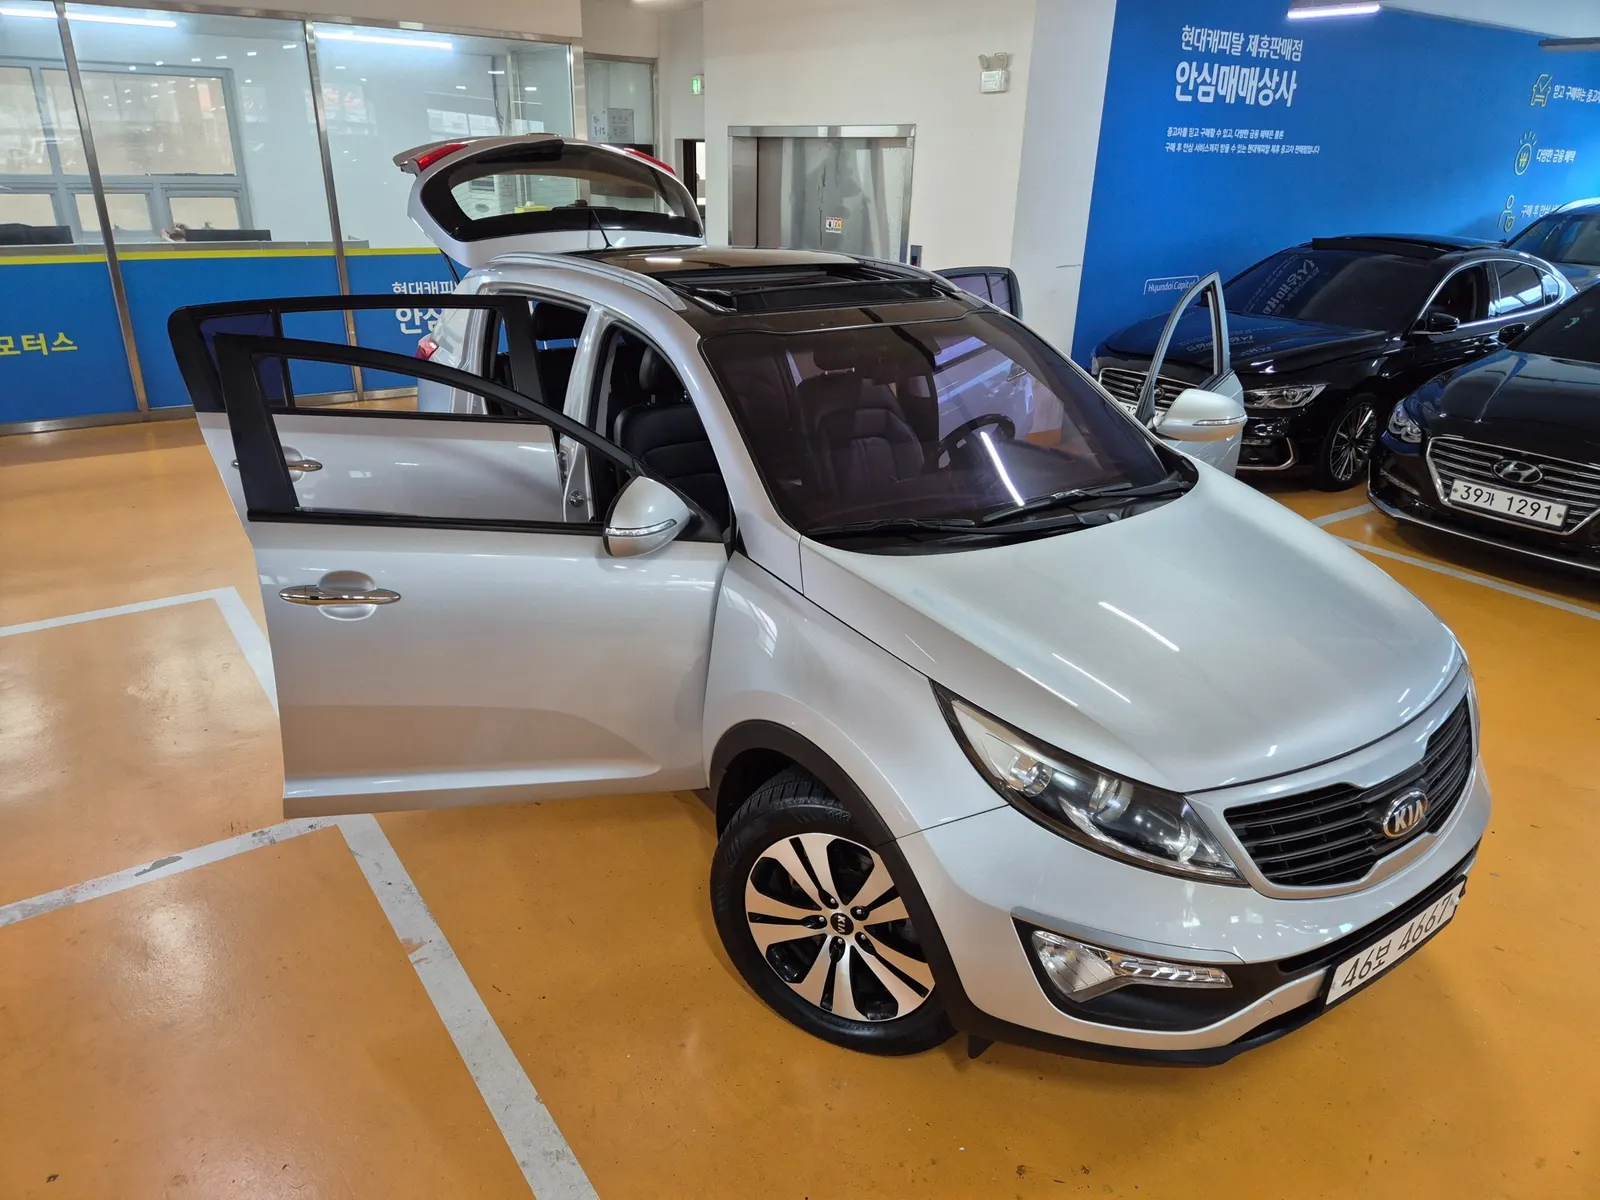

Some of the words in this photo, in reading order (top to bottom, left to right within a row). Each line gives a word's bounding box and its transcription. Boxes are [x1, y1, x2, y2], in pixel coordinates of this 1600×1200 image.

[1181, 24, 1245, 57] 현대캐피탈
[1246, 34, 1304, 62] 제휴판매점
[1175, 60, 1298, 108] 안심매매상사
[1553, 84, 1565, 99] 믿고
[1565, 86, 1587, 102] 구매하는
[1167, 126, 1188, 138] 중고차를
[1188, 127, 1199, 138] 믿고
[1200, 127, 1216, 138] 구매할
[1216, 128, 1222, 138] 수
[1234, 128, 1249, 139] 다양한
[1249, 129, 1260, 139] 금융
[1165, 142, 1176, 153] 구매
[1176, 142, 1182, 152] 후
[1183, 142, 1194, 153] 안심
[1194, 142, 1220, 153] 서비스까지
[1230, 143, 1236, 154] 수
[1236, 143, 1247, 154] 있는
[1280, 144, 1294, 154] 중고차
[1536, 148, 1553, 163] 다양한
[1552, 149, 1565, 163] 금융
[1564, 149, 1577, 163] 혜택
[1521, 204, 1533, 218] 구매
[1532, 204, 1540, 218] 후
[391, 280, 458, 295] 현대캐피
[1148, 280, 1173, 294] Hyundai
[0, 332, 78, 356] 모터스
[1460, 484, 1495, 506] 39가
[1506, 496, 1552, 521] 1291
[1393, 799, 1424, 833] KIA
[837, 914, 846, 933] KIA
[1341, 939, 1392, 988] 46보
[1397, 892, 1453, 951] 4667
